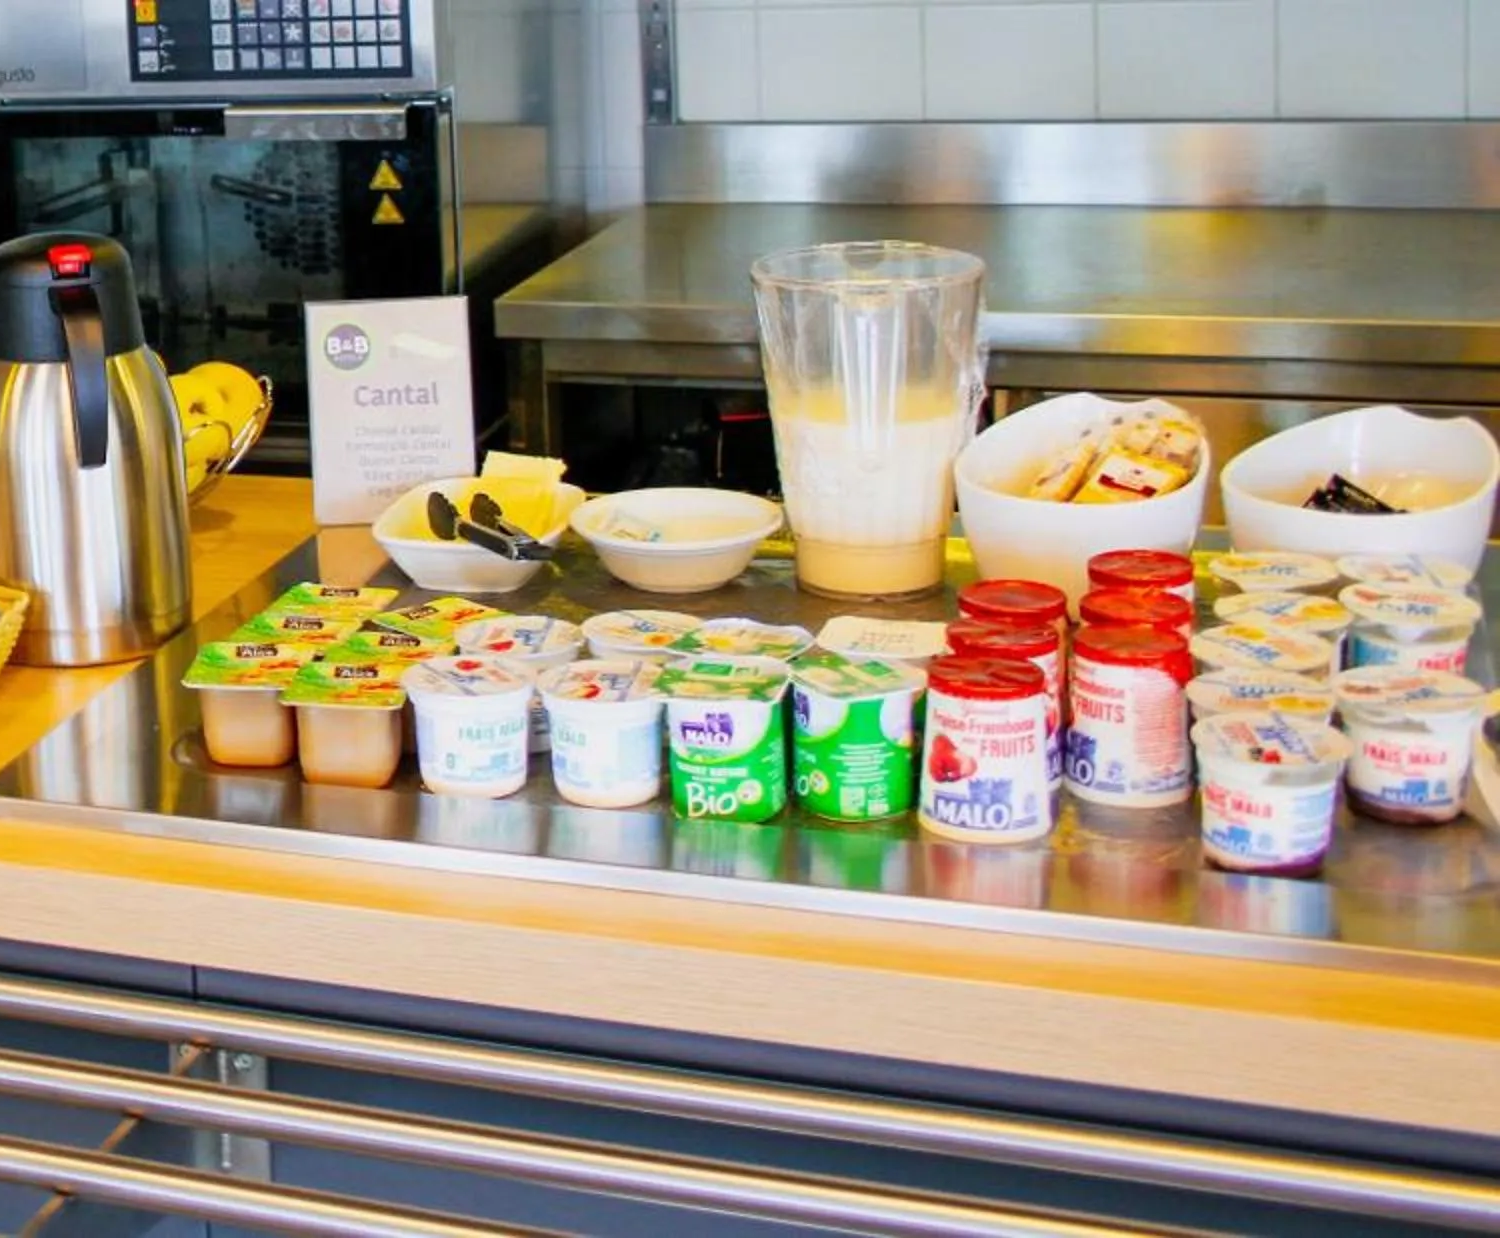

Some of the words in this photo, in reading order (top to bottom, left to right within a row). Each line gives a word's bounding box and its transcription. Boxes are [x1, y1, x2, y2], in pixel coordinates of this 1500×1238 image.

[327, 335, 368, 354] B&B
[354, 381, 439, 407] Cantal
[685, 728, 729, 744] MALO
[980, 735, 1036, 758] FRUITS
[1363, 742, 1402, 763] FRAIS
[685, 781, 739, 818] Bio
[937, 799, 1010, 830] MALO
